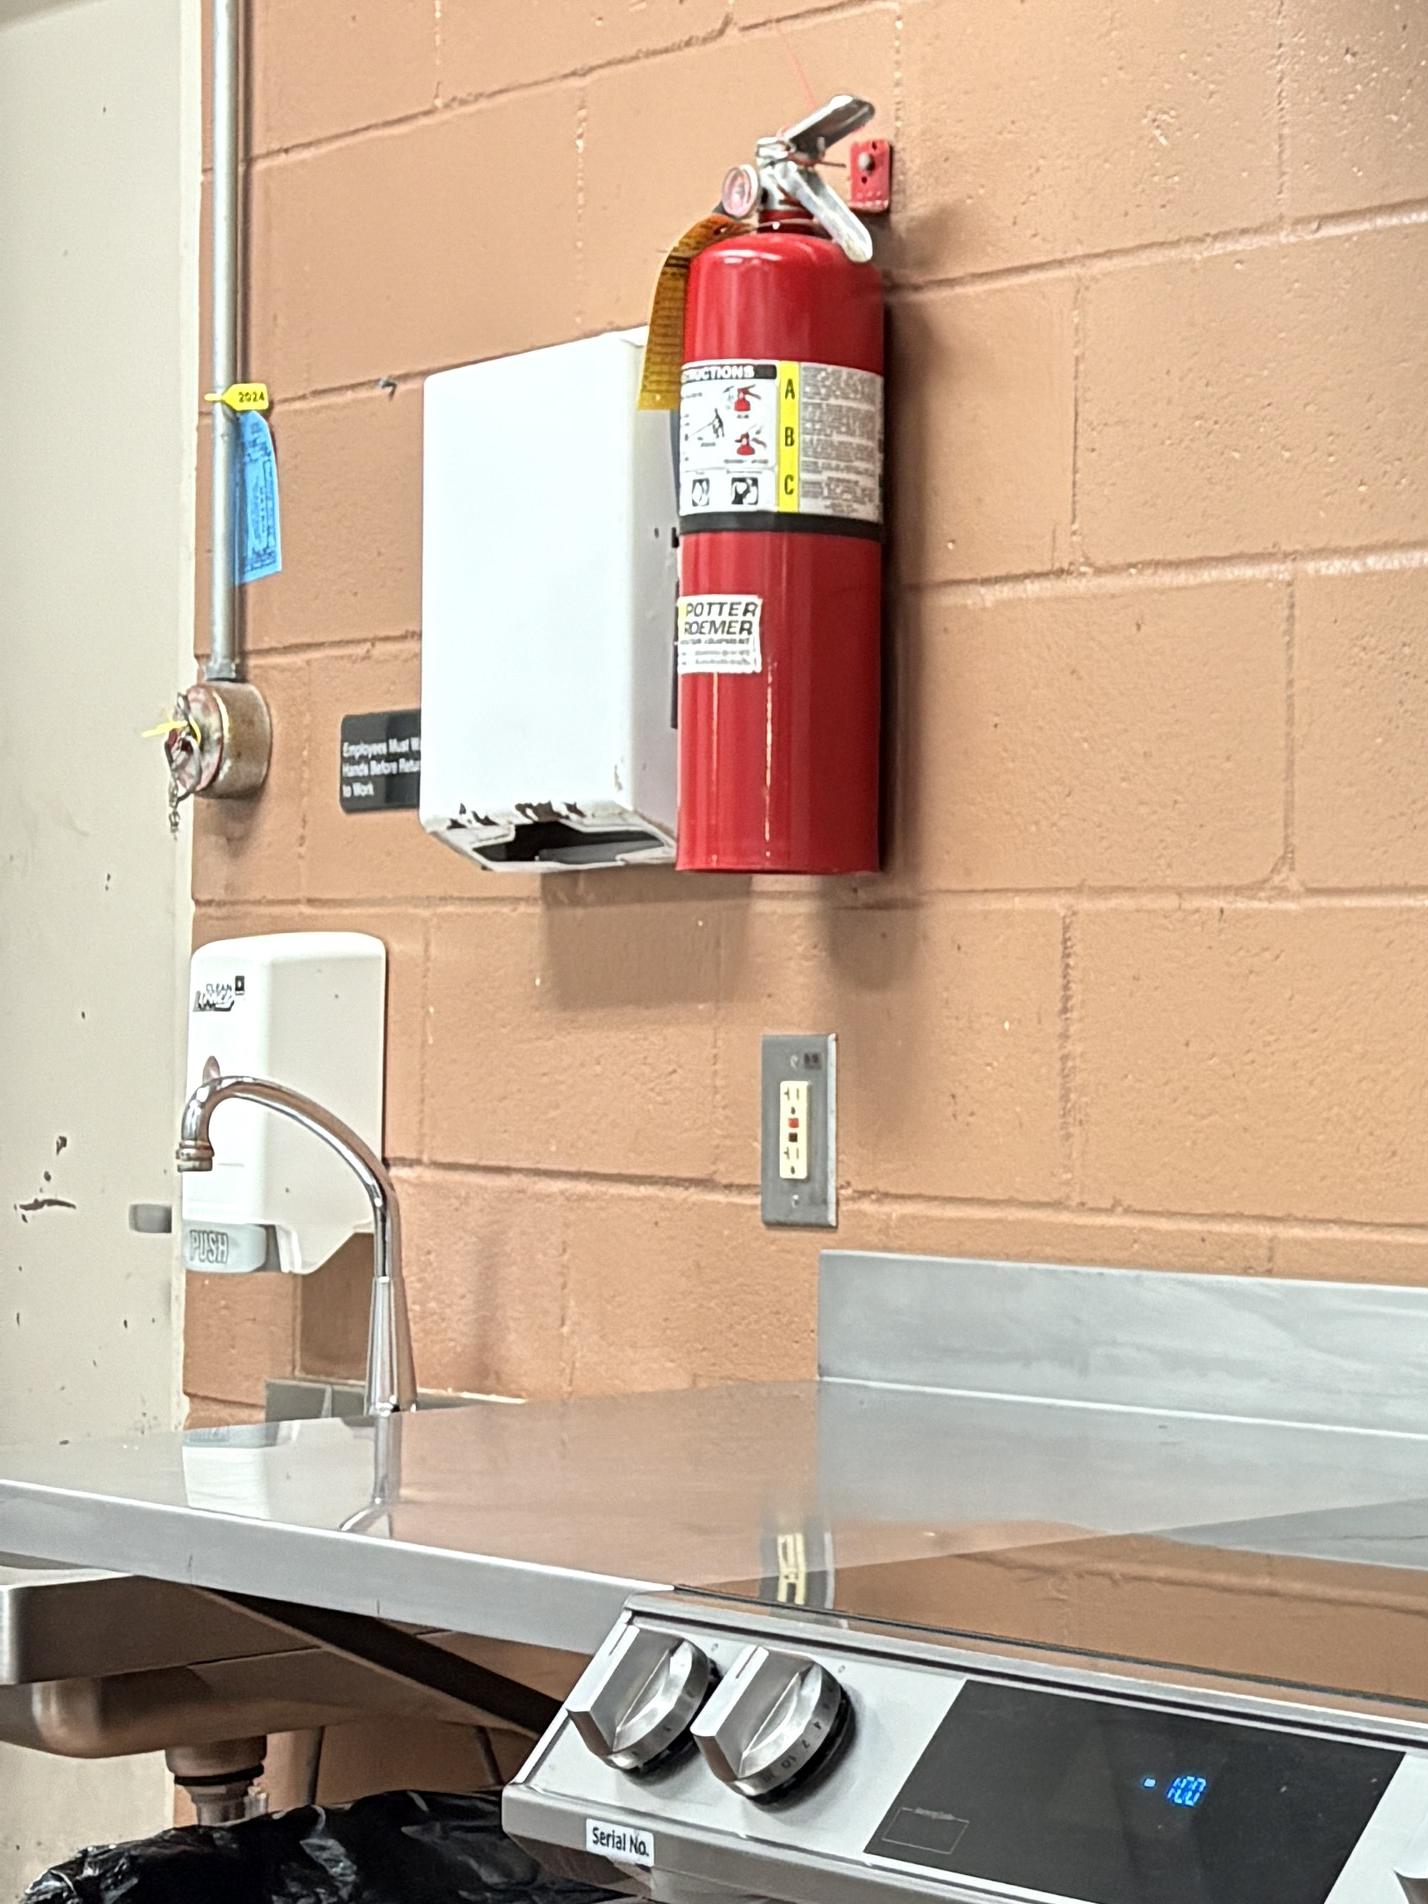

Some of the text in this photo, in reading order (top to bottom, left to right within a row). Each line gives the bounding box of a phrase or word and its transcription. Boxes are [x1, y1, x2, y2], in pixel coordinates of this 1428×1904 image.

[238, 391, 265, 403] 2024
[784, 378, 796, 400] A
[784, 426, 795, 447] B
[784, 474, 795, 495] C
[686, 601, 759, 617] POTTER
[684, 620, 753, 636] ROEMER
[189, 1229, 229, 1264] PUSH
[592, 1826, 649, 1857] Serial No.
